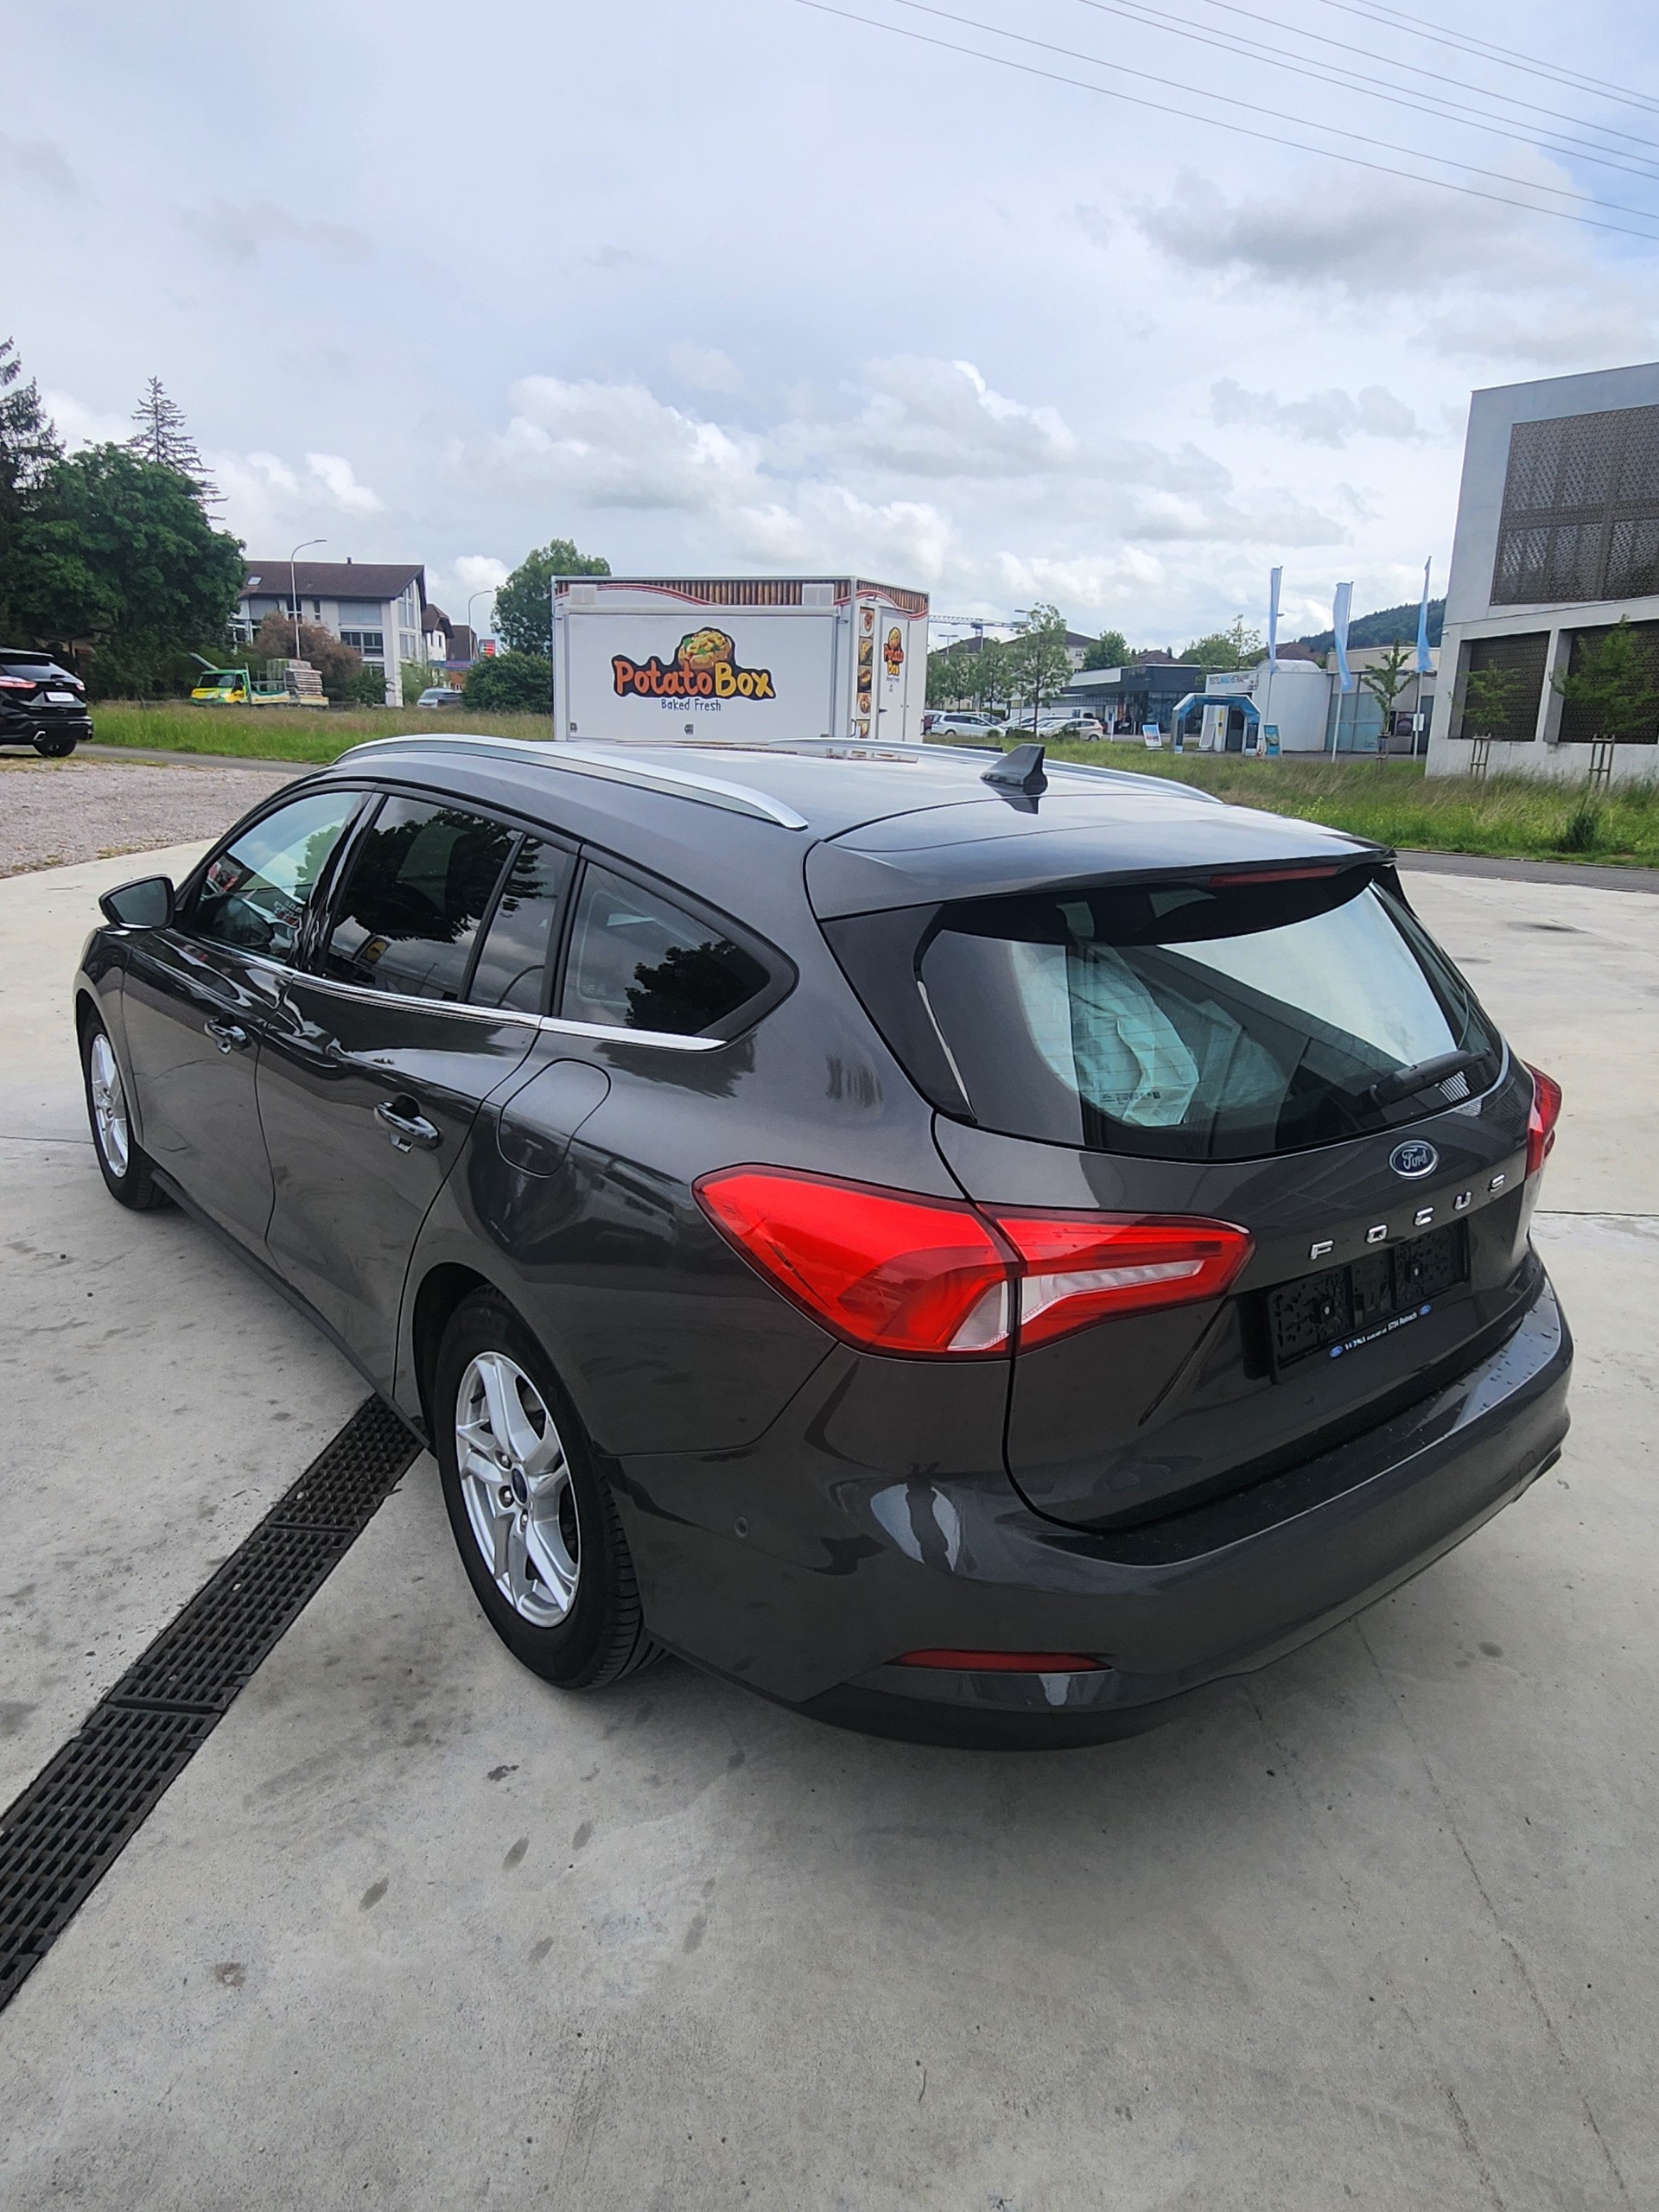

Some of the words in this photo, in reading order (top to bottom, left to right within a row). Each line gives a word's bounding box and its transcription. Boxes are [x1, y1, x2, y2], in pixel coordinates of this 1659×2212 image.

[661, 698, 690, 711] Baked
[695, 698, 721, 712] Fresh
[1402, 1147, 1428, 1170] Ford
[1310, 1173, 1505, 1260] FOCUS
